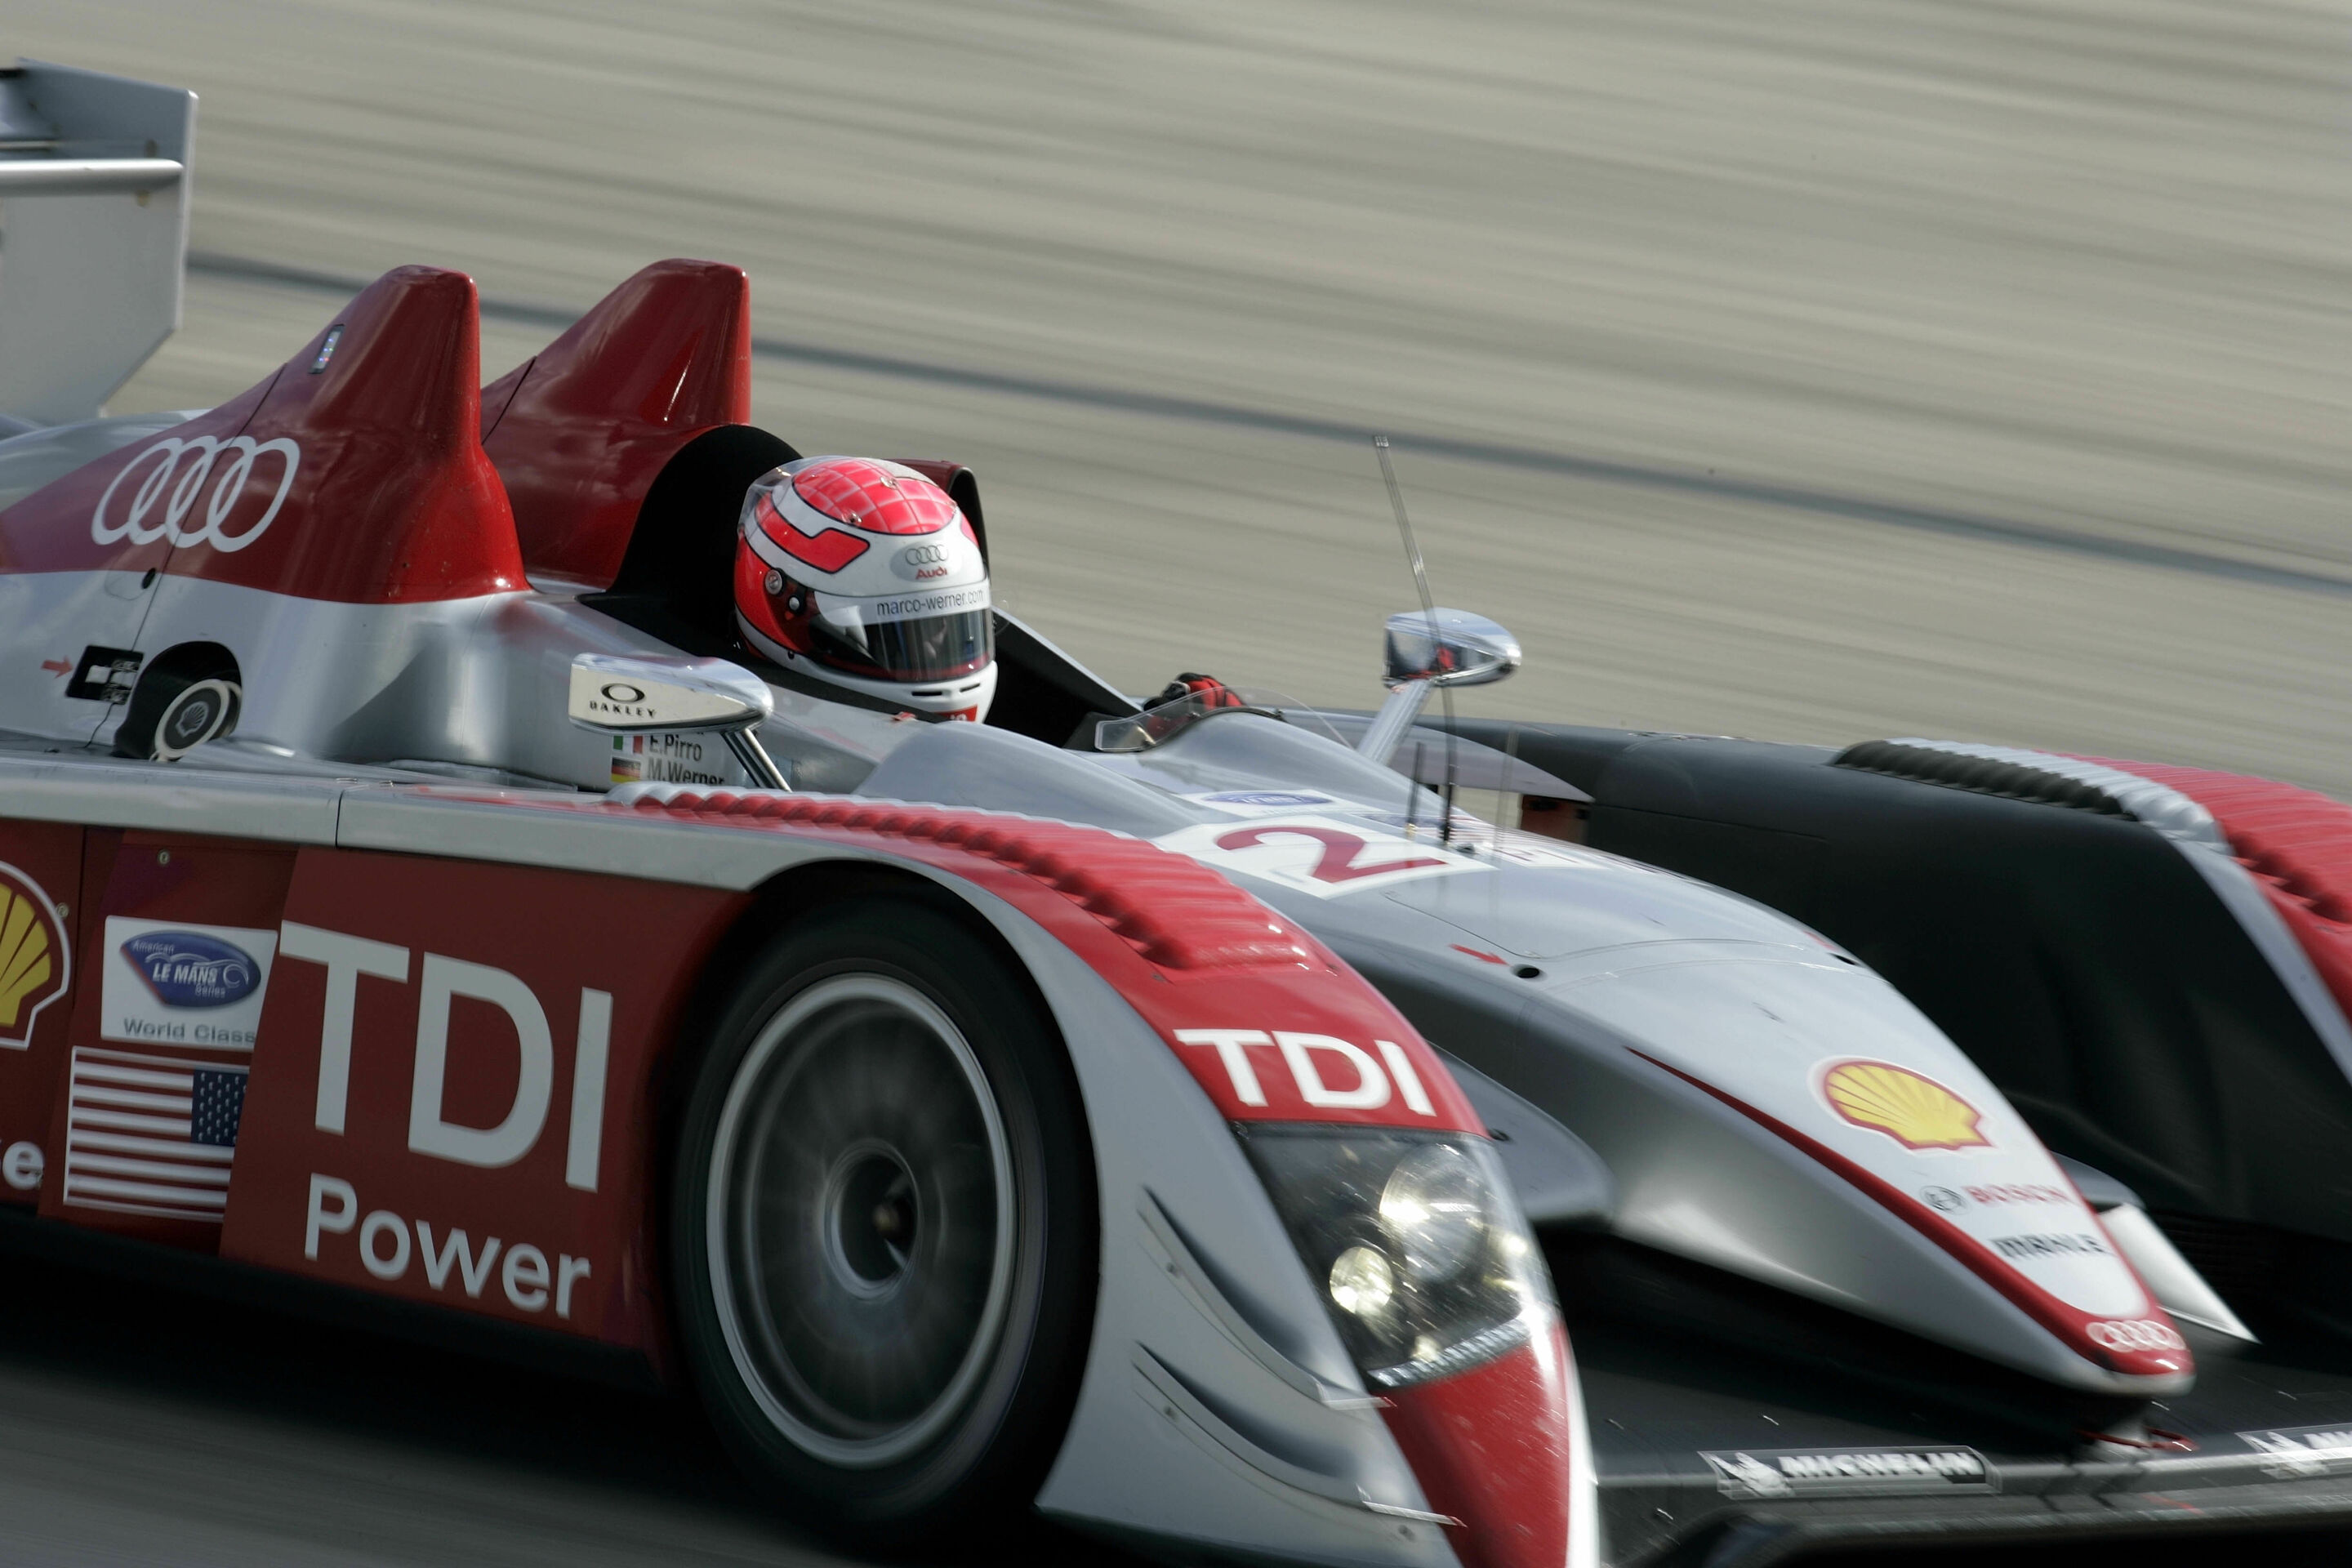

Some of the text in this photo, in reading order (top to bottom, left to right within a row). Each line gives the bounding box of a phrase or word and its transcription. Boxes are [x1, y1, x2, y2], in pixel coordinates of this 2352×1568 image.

[915, 565, 948, 581] Audi
[875, 587, 985, 617] marco-werner.com
[588, 700, 657, 719] OAKLEY
[1214, 826, 1450, 884] 2
[152, 961, 219, 986] LE MANS
[123, 1018, 256, 1044] World Class
[278, 920, 614, 1194] TDI
[1172, 1028, 1437, 1117] TDI
[304, 1171, 592, 1321] Power
[1778, 1452, 1984, 1478] MICHELIN
